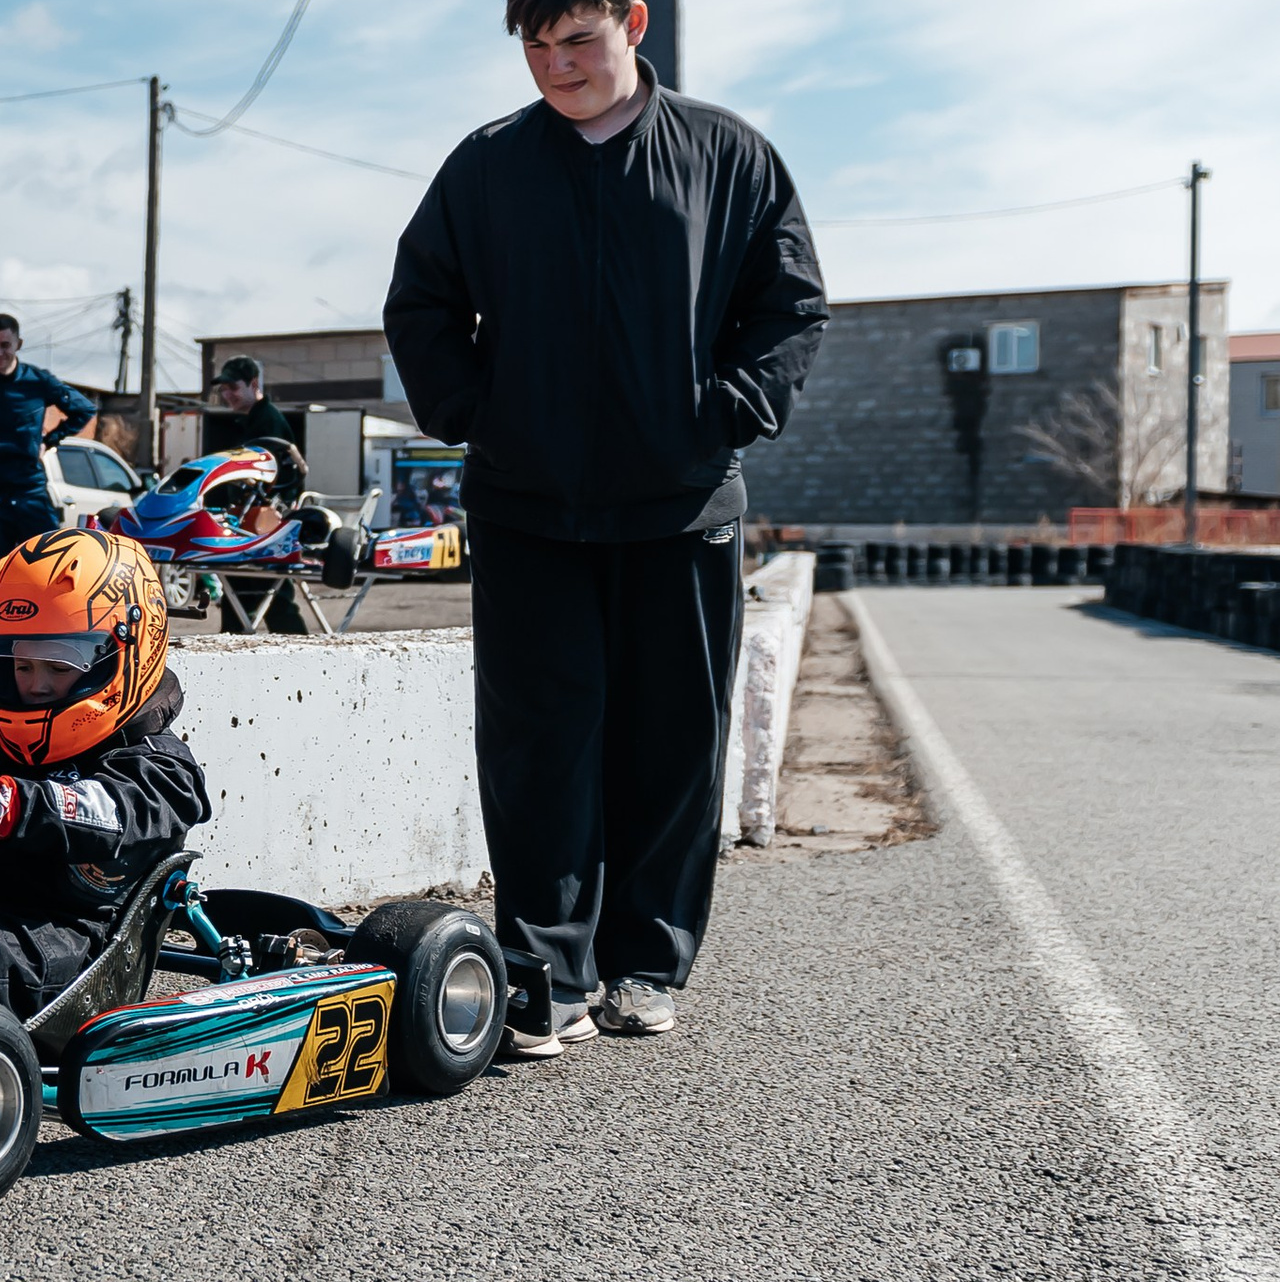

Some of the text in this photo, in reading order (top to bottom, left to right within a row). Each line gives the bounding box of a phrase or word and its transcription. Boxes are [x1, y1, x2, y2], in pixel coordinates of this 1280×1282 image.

[329, 963, 374, 976] RACING
[303, 994, 388, 1105] 22
[125, 1050, 272, 1091] FORMULA K
